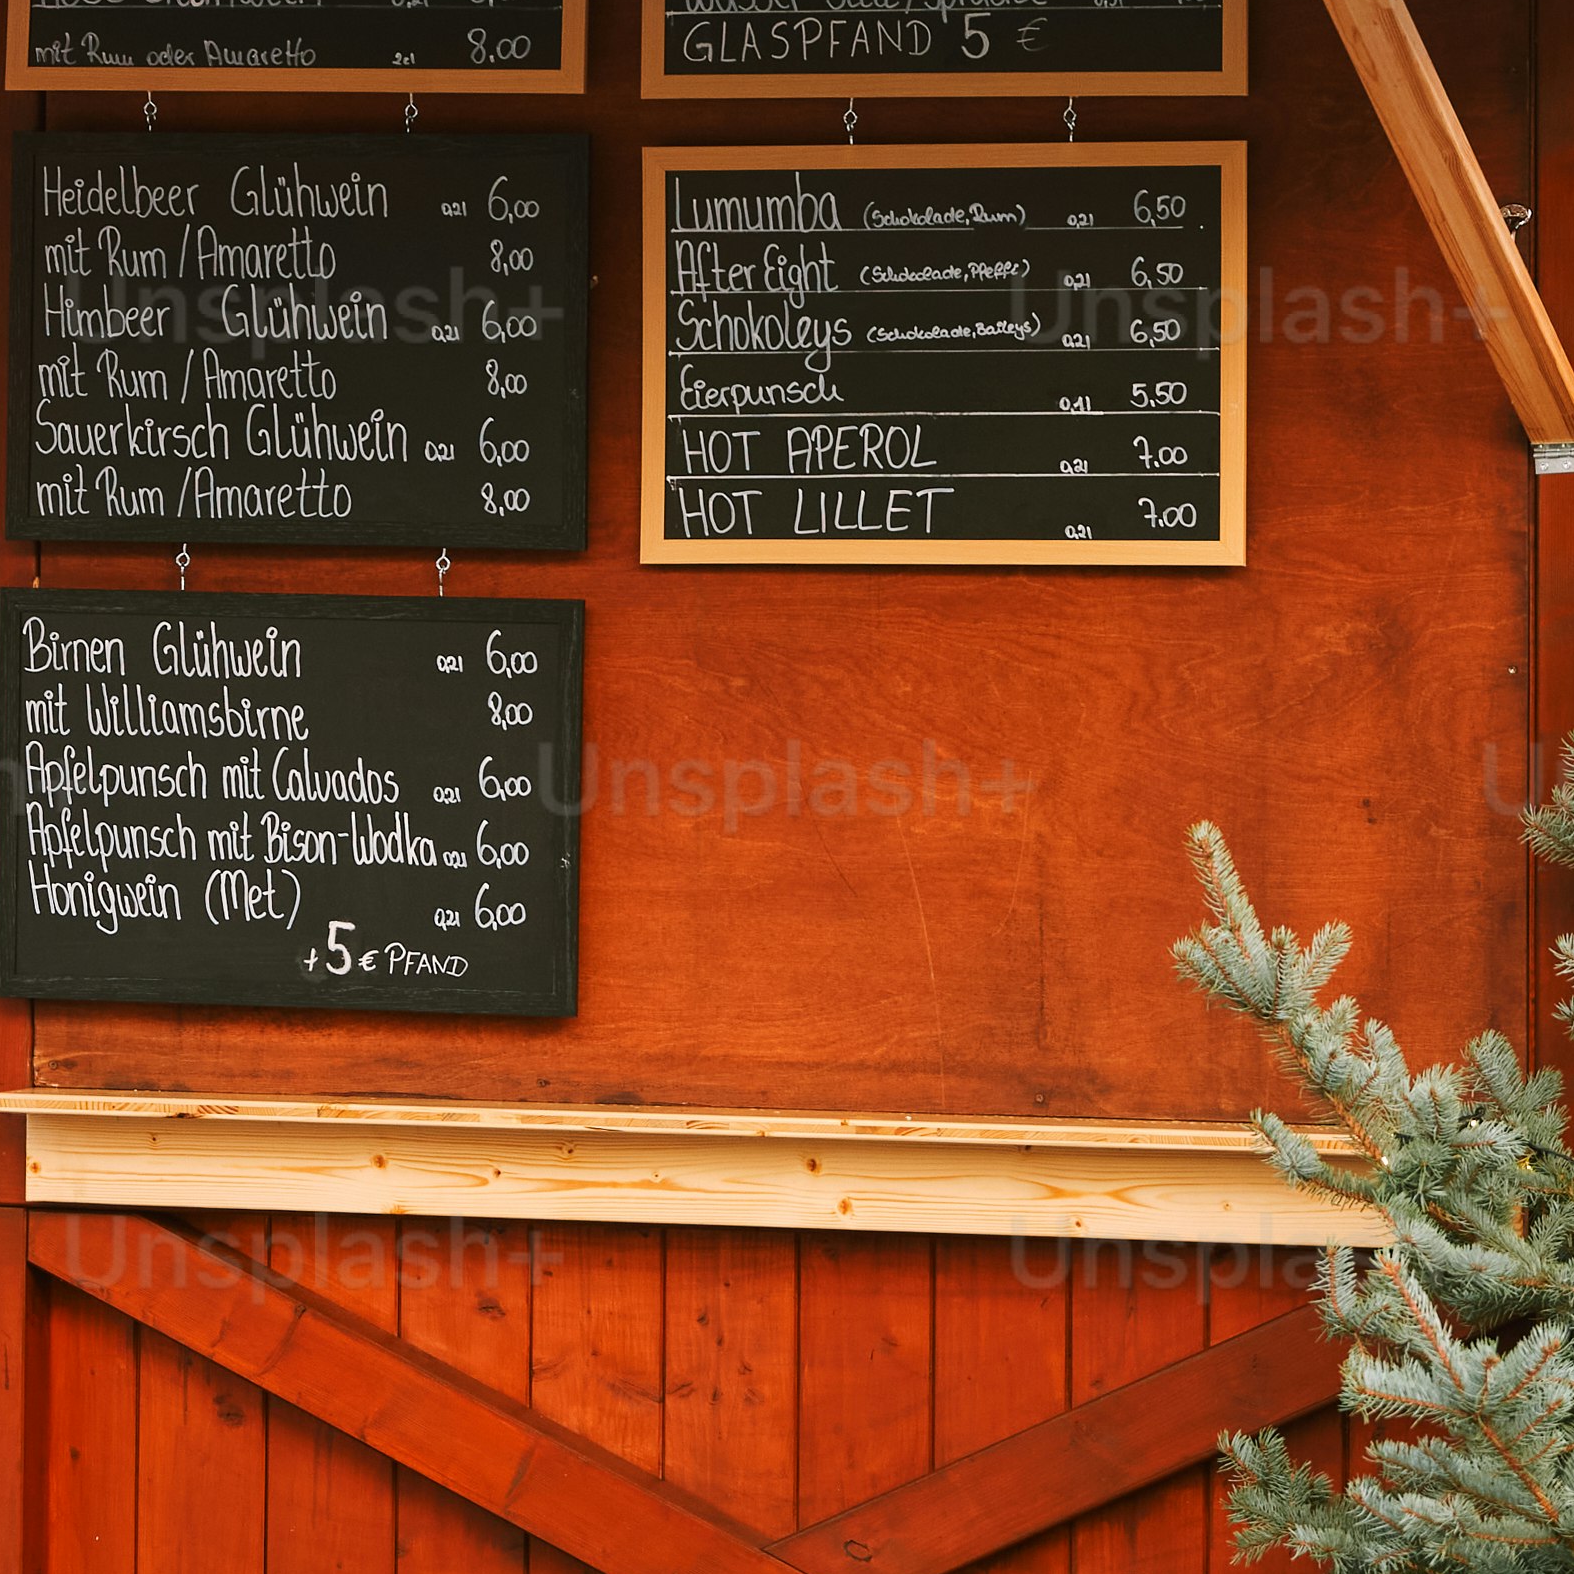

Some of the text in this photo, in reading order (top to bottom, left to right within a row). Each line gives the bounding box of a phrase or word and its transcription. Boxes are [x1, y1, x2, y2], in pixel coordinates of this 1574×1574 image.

[35, 33, 76, 65] mit
[81, 31, 135, 68] Rum
[146, 41, 196, 67] oder
[205, 37, 317, 67] Amaretto
[467, 28, 532, 66] 8,00
[683, 13, 1049, 64] GLASPFAND 5 €
[42, 165, 200, 219] Heidelbeer
[230, 162, 389, 220] Glühwein
[487, 175, 541, 225] 6,00
[673, 171, 843, 233] Lumumba
[1132, 189, 1187, 228] 6,50
[44, 226, 93, 278] mit
[97, 225, 167, 280] Rum
[489, 238, 534, 277] 8,00
[674, 238, 758, 301] After
[761, 239, 840, 309] Eight
[1130, 255, 1185, 291] 6,50
[43, 282, 171, 339] Himbeer
[221, 282, 389, 341] Glühwein
[480, 298, 538, 344] 6,00
[676, 298, 852, 373] Schokoleys
[1129, 317, 1182, 349] 6,50
[37, 342, 87, 400] mit
[96, 347, 169, 401] Rum
[485, 358, 528, 400] 8,00
[679, 363, 845, 417] Eierpunsch
[34, 397, 229, 459] Sauerkirsch
[245, 402, 409, 464] Glühwein
[478, 416, 531, 468] 6,00
[681, 428, 762, 475] HOT
[787, 423, 938, 474] APEROL
[35, 463, 89, 518] mit
[94, 464, 166, 519] Rum
[480, 481, 531, 518] 8,00
[678, 488, 763, 539] HOT
[793, 486, 955, 536] LILLET
[22, 615, 126, 676] Birnen
[152, 620, 303, 680] Glühwein
[485, 628, 539, 679] 6,00
[25, 682, 534, 742] mit Williamsbirne 8,00
[25, 739, 208, 809] Apfelpunsch
[222, 753, 265, 802] mit
[271, 746, 401, 805] Calvados
[478, 754, 533, 802] 6,00
[25, 800, 197, 873] Apfelpunsch
[207, 811, 256, 863] mit
[259, 810, 438, 868] Bison-Wodka
[476, 818, 531, 870] 6,00
[27, 859, 183, 936] Honigwein
[204, 867, 303, 931] (Met)
[474, 882, 527, 931] 6,00
[383, 941, 470, 978] PFAND
